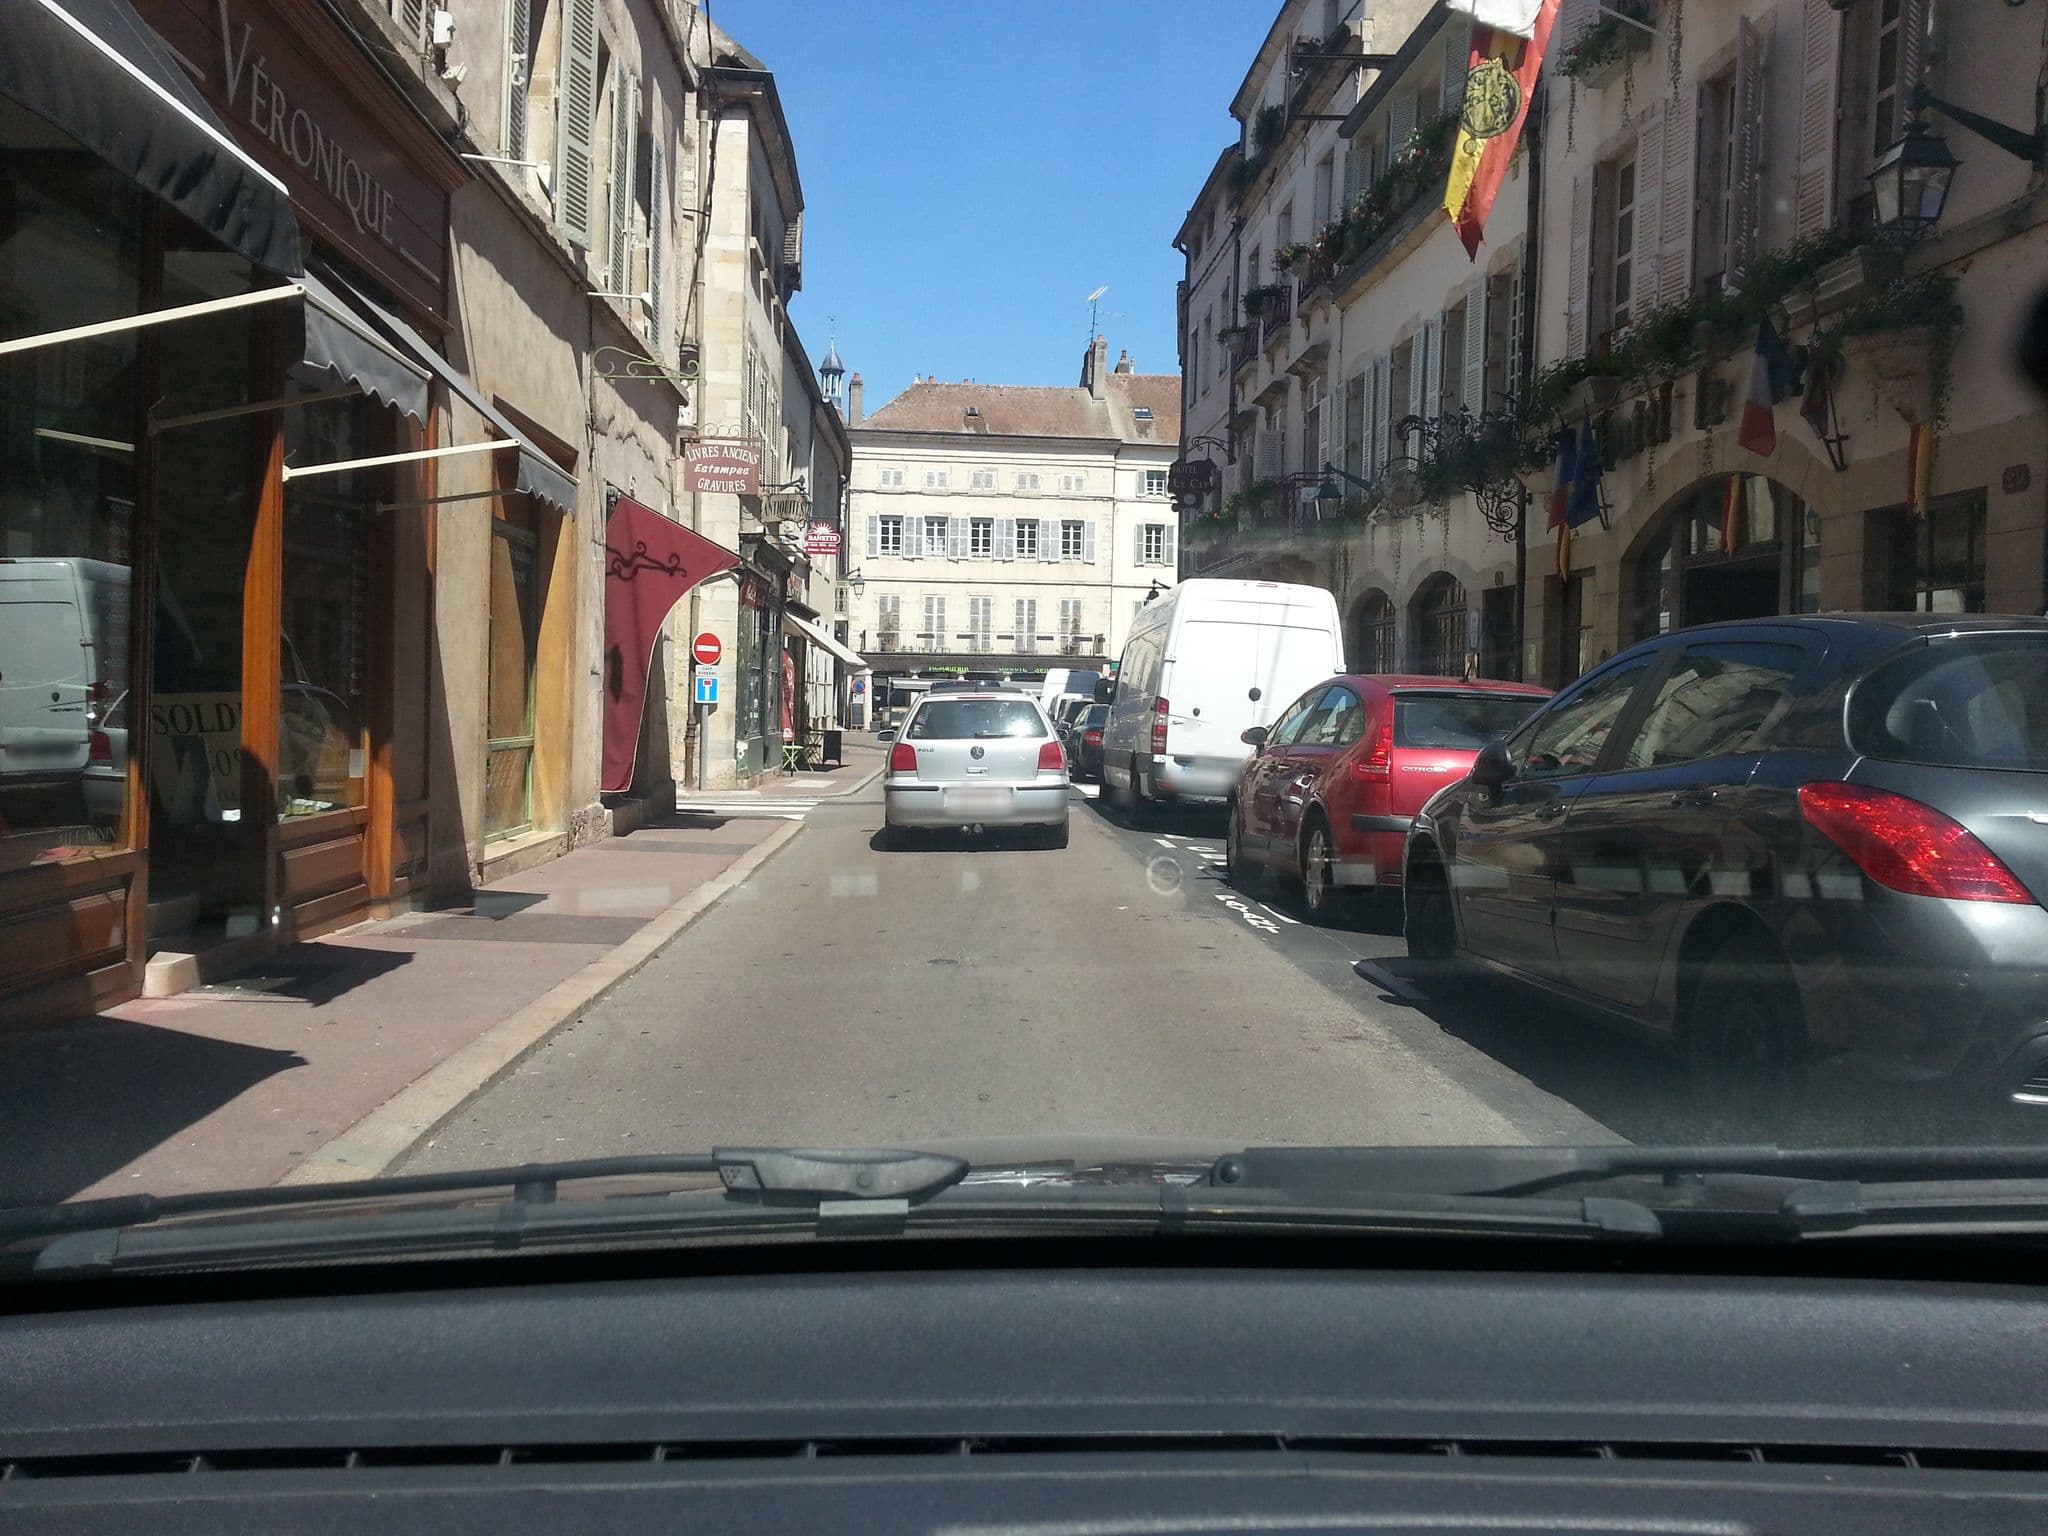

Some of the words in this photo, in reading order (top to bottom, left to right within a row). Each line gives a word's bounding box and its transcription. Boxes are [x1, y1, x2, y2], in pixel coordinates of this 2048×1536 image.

[686, 445, 719, 462] LIVRES
[722, 446, 760, 466] ANCIENS
[697, 477, 747, 493] GRAVURES
[152, 702, 242, 736] SOLD
